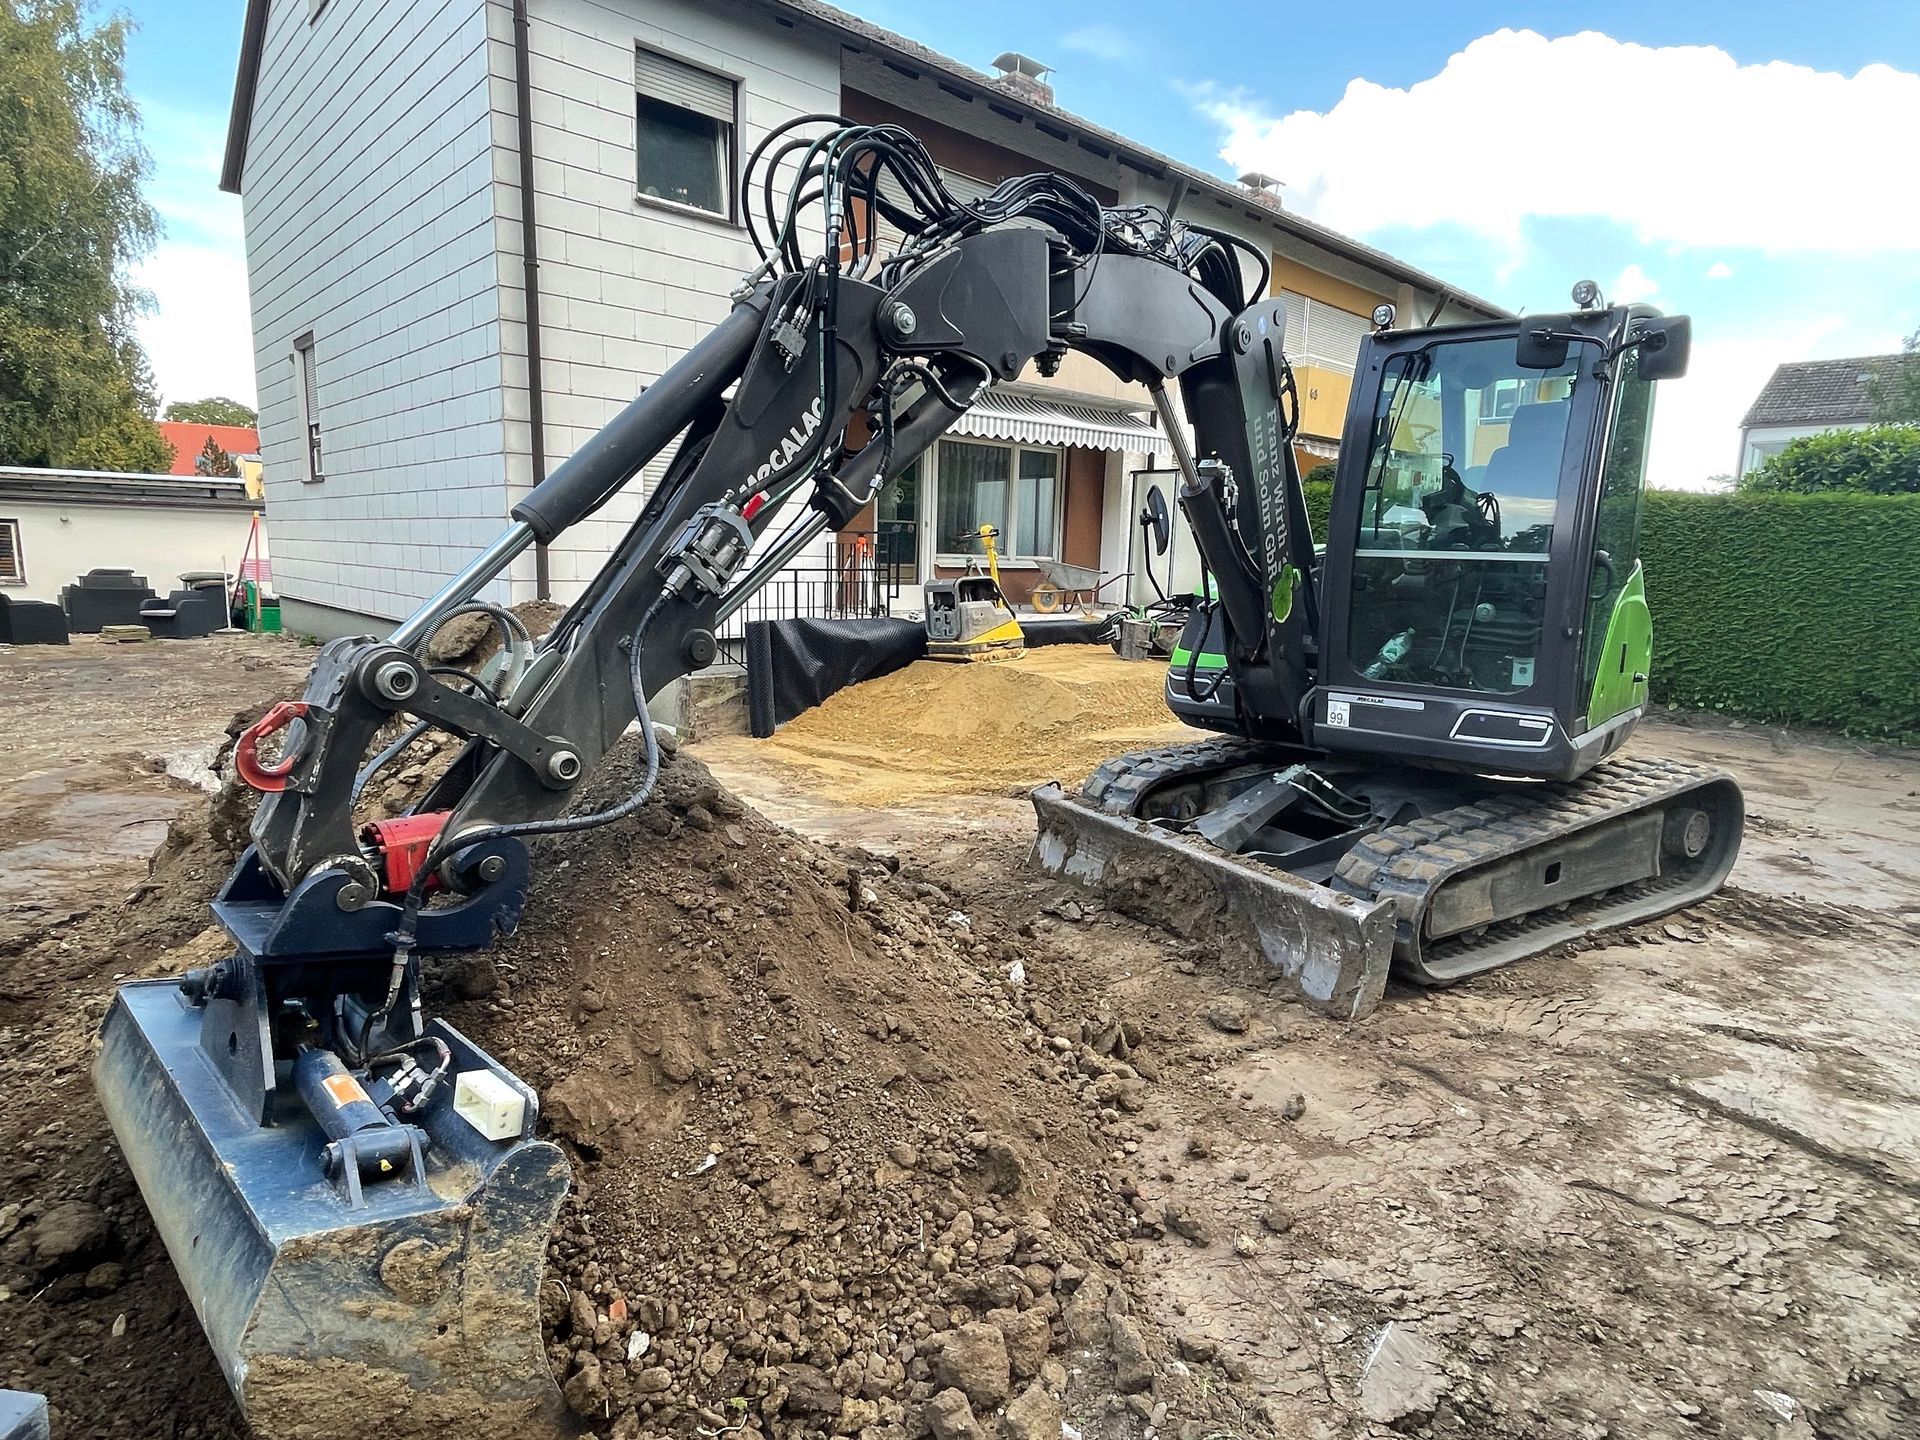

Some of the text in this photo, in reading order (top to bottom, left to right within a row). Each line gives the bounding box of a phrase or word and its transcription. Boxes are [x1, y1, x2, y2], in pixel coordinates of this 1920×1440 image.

[1254, 416, 1277, 582] und Sohn GbR
[1266, 408, 1287, 550] Franz Wirth
[1329, 711, 1343, 724] 99
